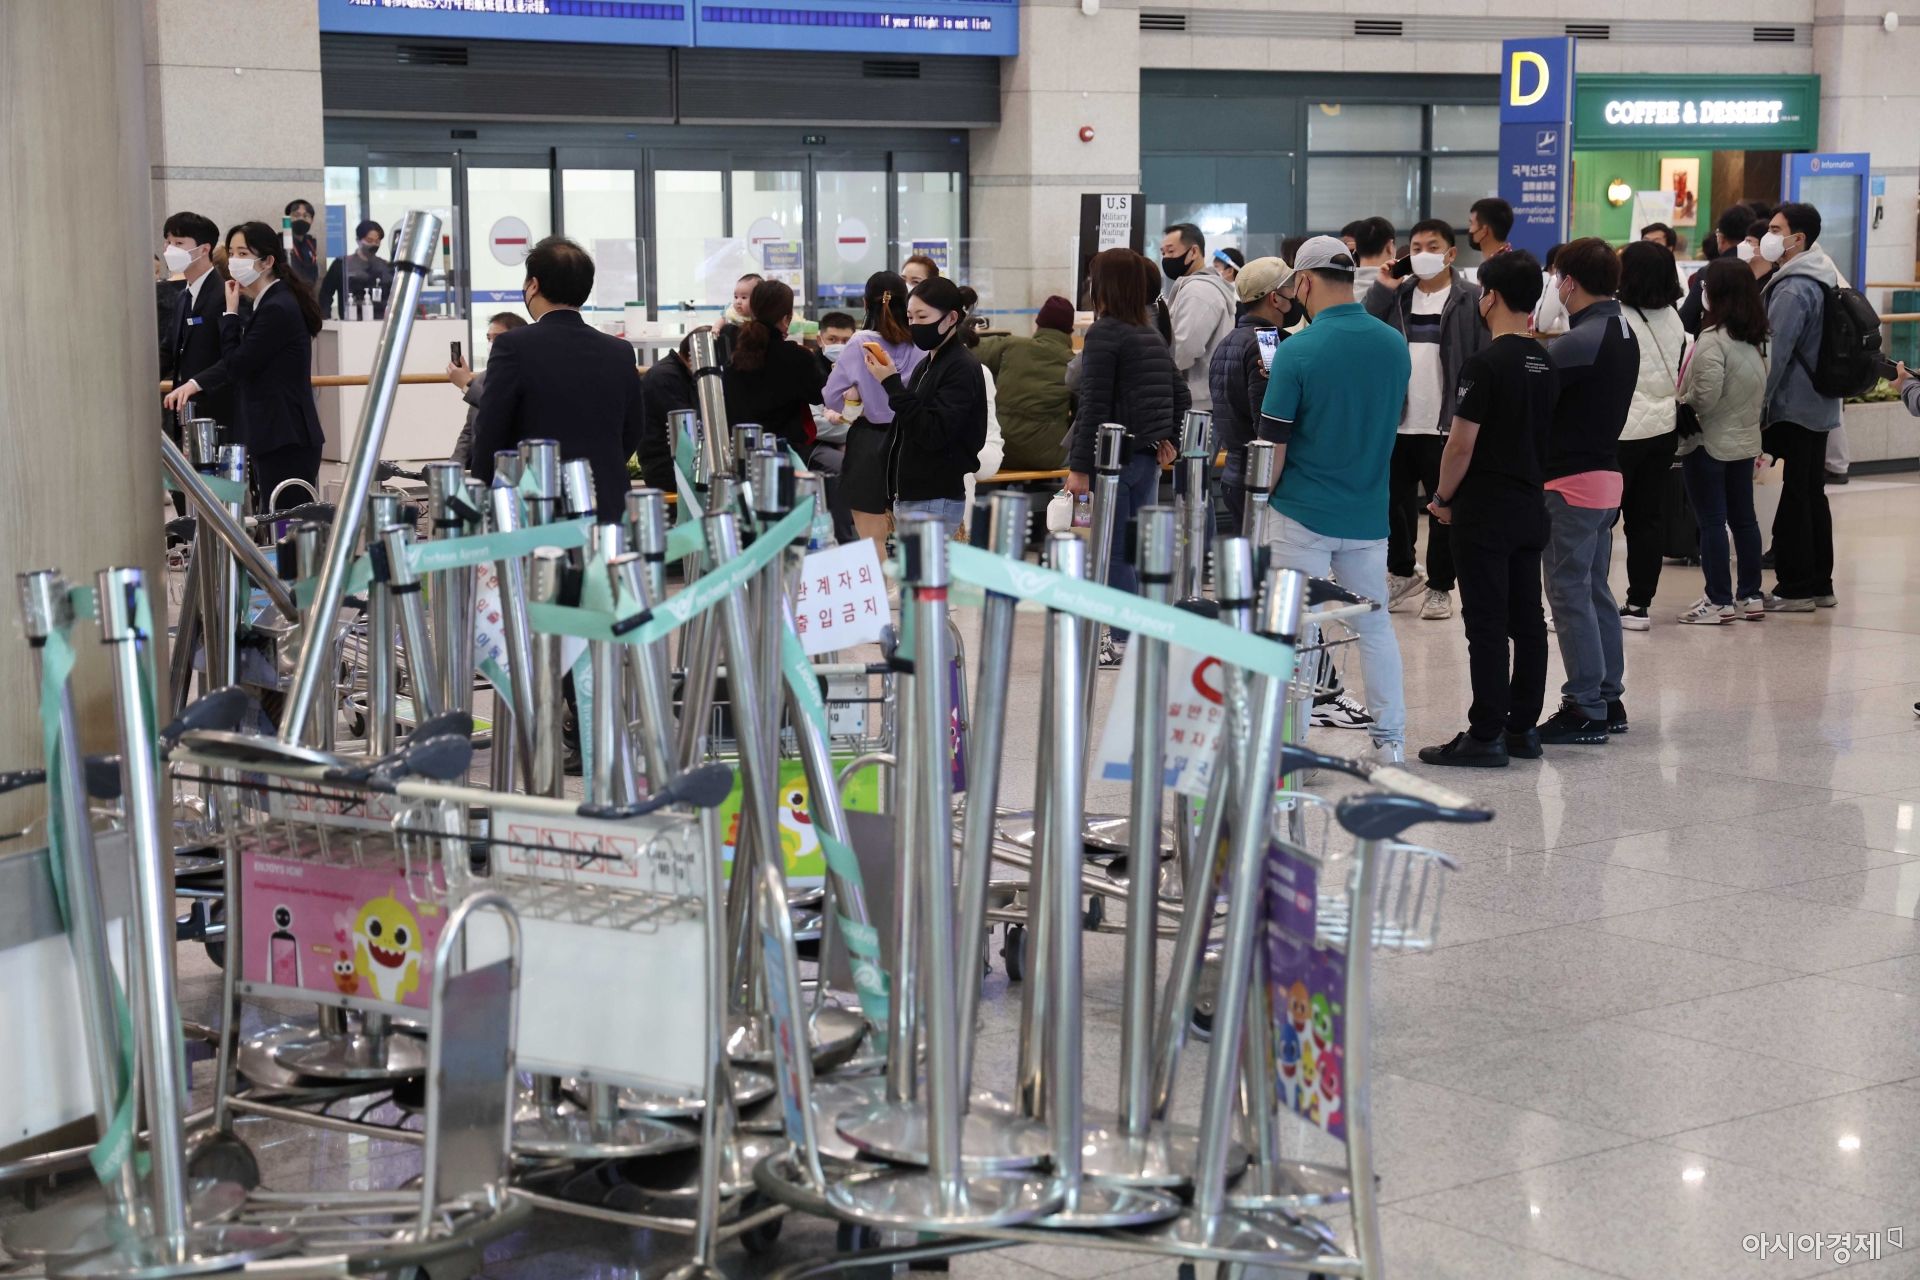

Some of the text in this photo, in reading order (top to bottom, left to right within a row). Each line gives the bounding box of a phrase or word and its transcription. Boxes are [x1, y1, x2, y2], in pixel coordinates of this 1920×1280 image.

[881, 15, 889, 27] If
[1510, 51, 1549, 106] D
[1604, 100, 1783, 124] COFFEE & DESSERT
[1512, 164, 1556, 177] 국제선도착
[1820, 160, 1855, 169] Information
[1106, 197, 1127, 210] U.S
[1102, 212, 1128, 221] Military
[1512, 206, 1556, 215] nternational
[1527, 215, 1555, 224] Arrivals
[796, 596, 878, 634] 출입금지
[1119, 607, 1174, 632] Airport
